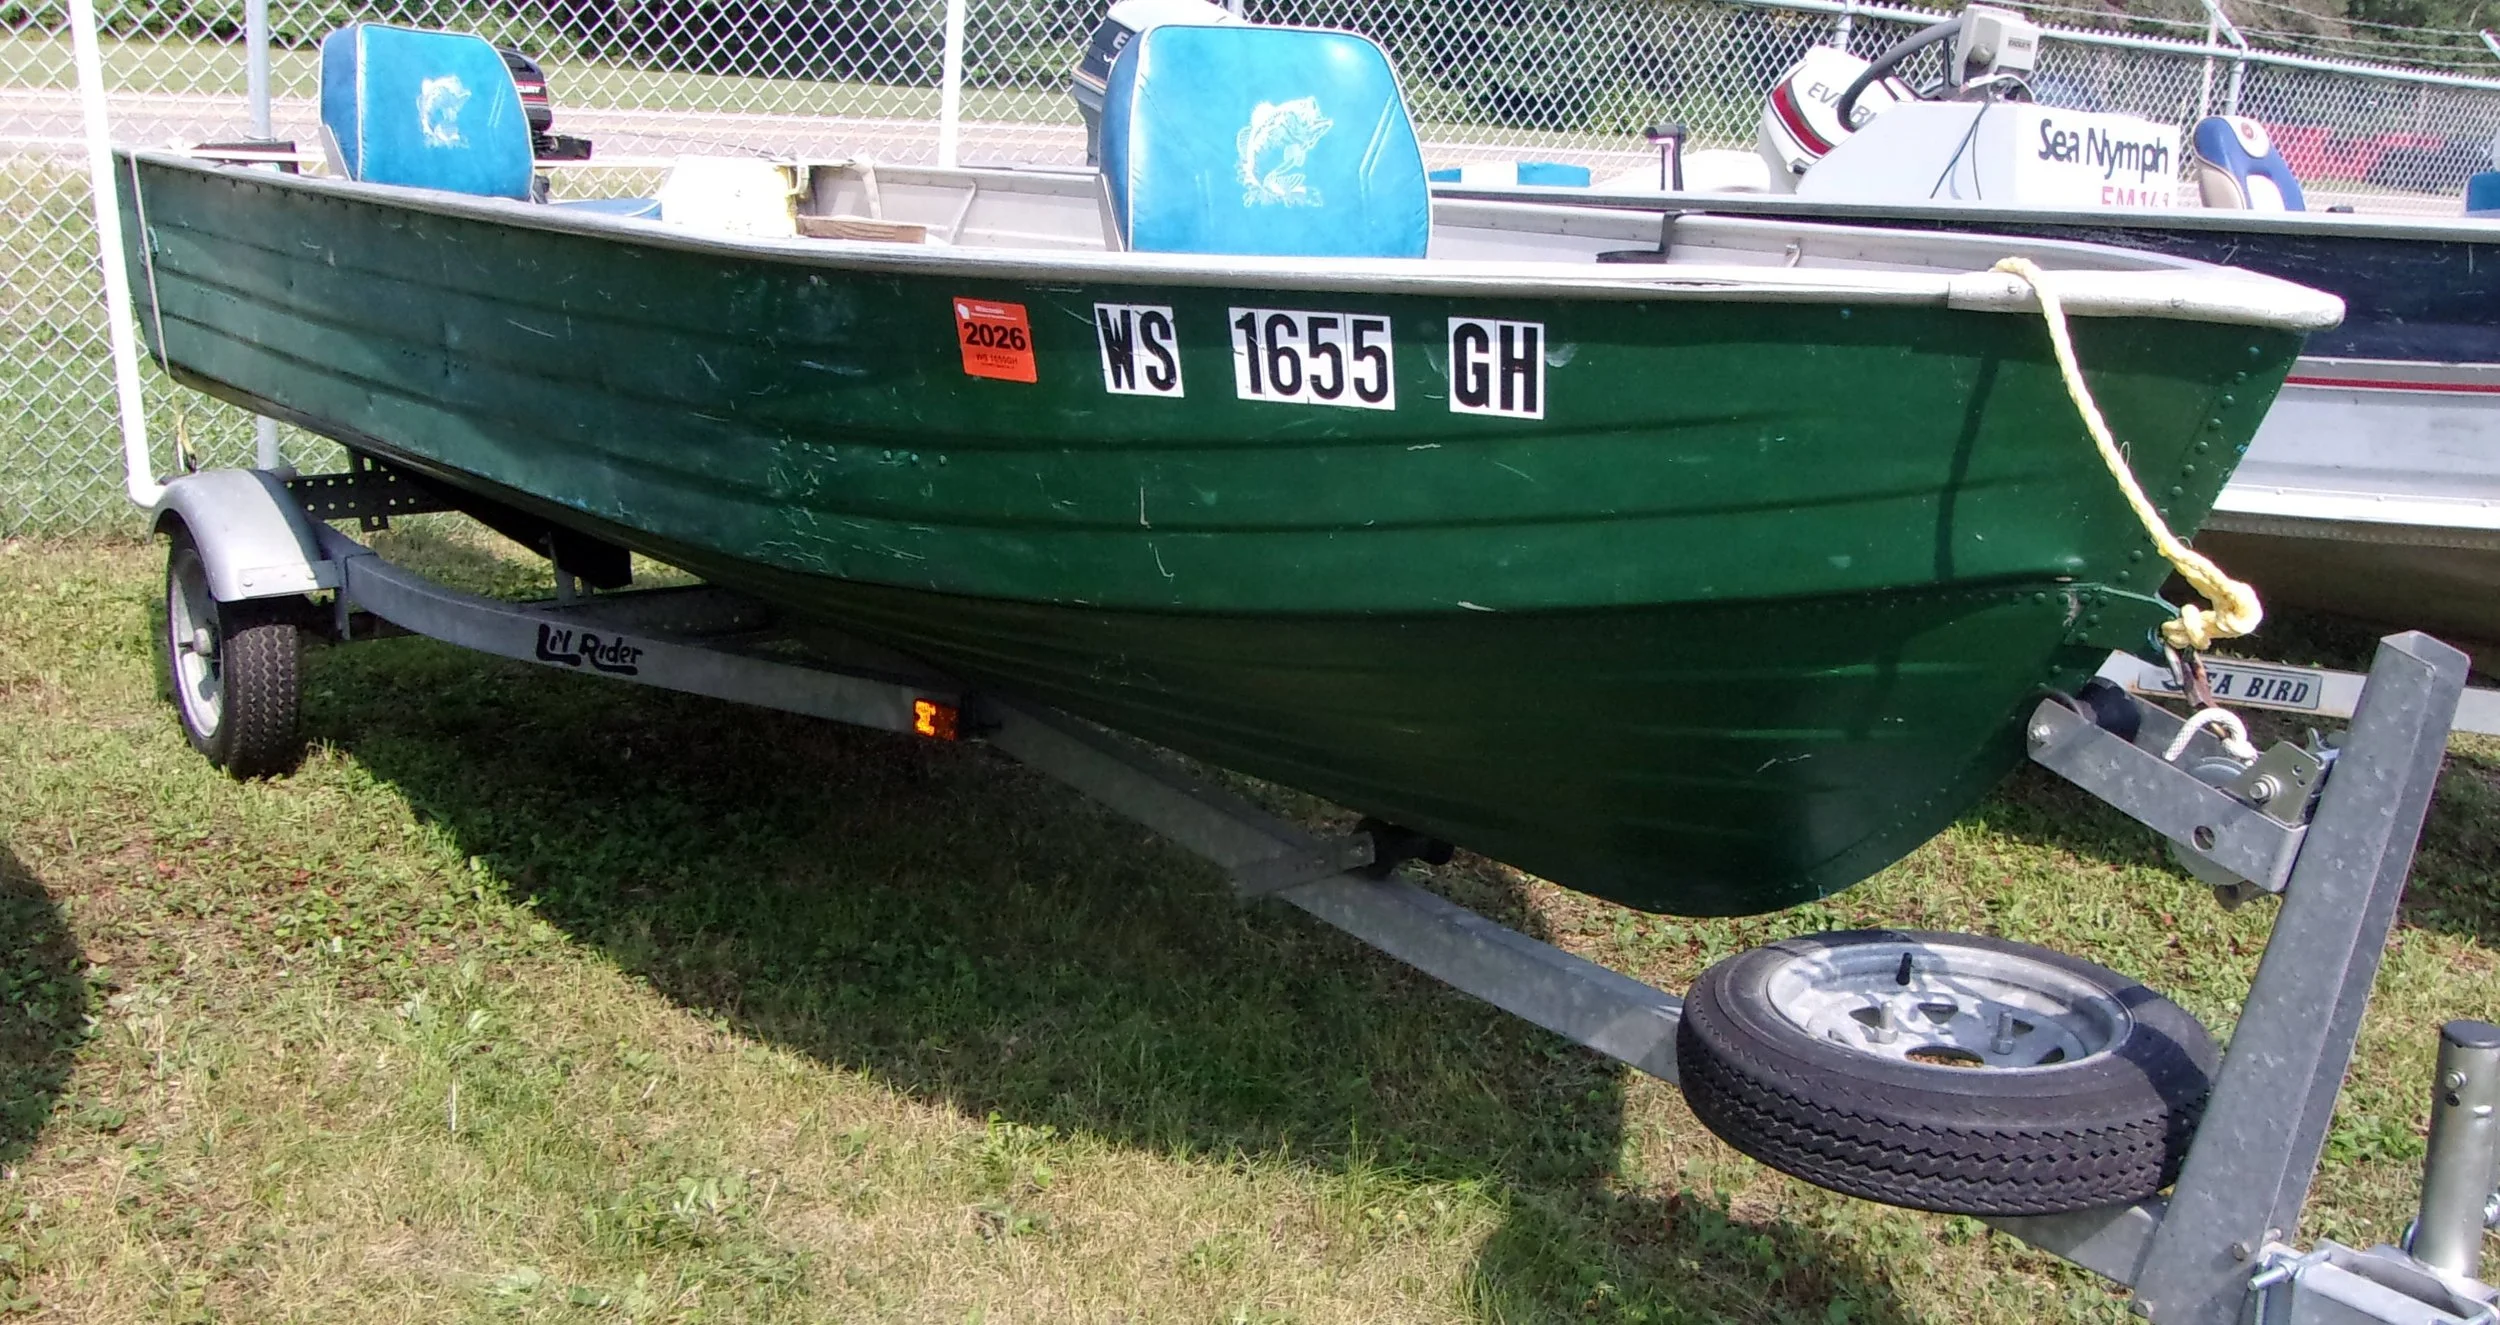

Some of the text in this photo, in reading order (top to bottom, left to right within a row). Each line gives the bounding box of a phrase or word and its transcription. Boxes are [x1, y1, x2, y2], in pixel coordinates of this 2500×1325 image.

[2038, 118, 2169, 184] Sea Nymph
[963, 322, 1026, 351] 2026
[1096, 307, 1538, 413] WS 1655 GH
[579, 633, 643, 676] Rider
[2244, 676, 2310, 704] BIRD
